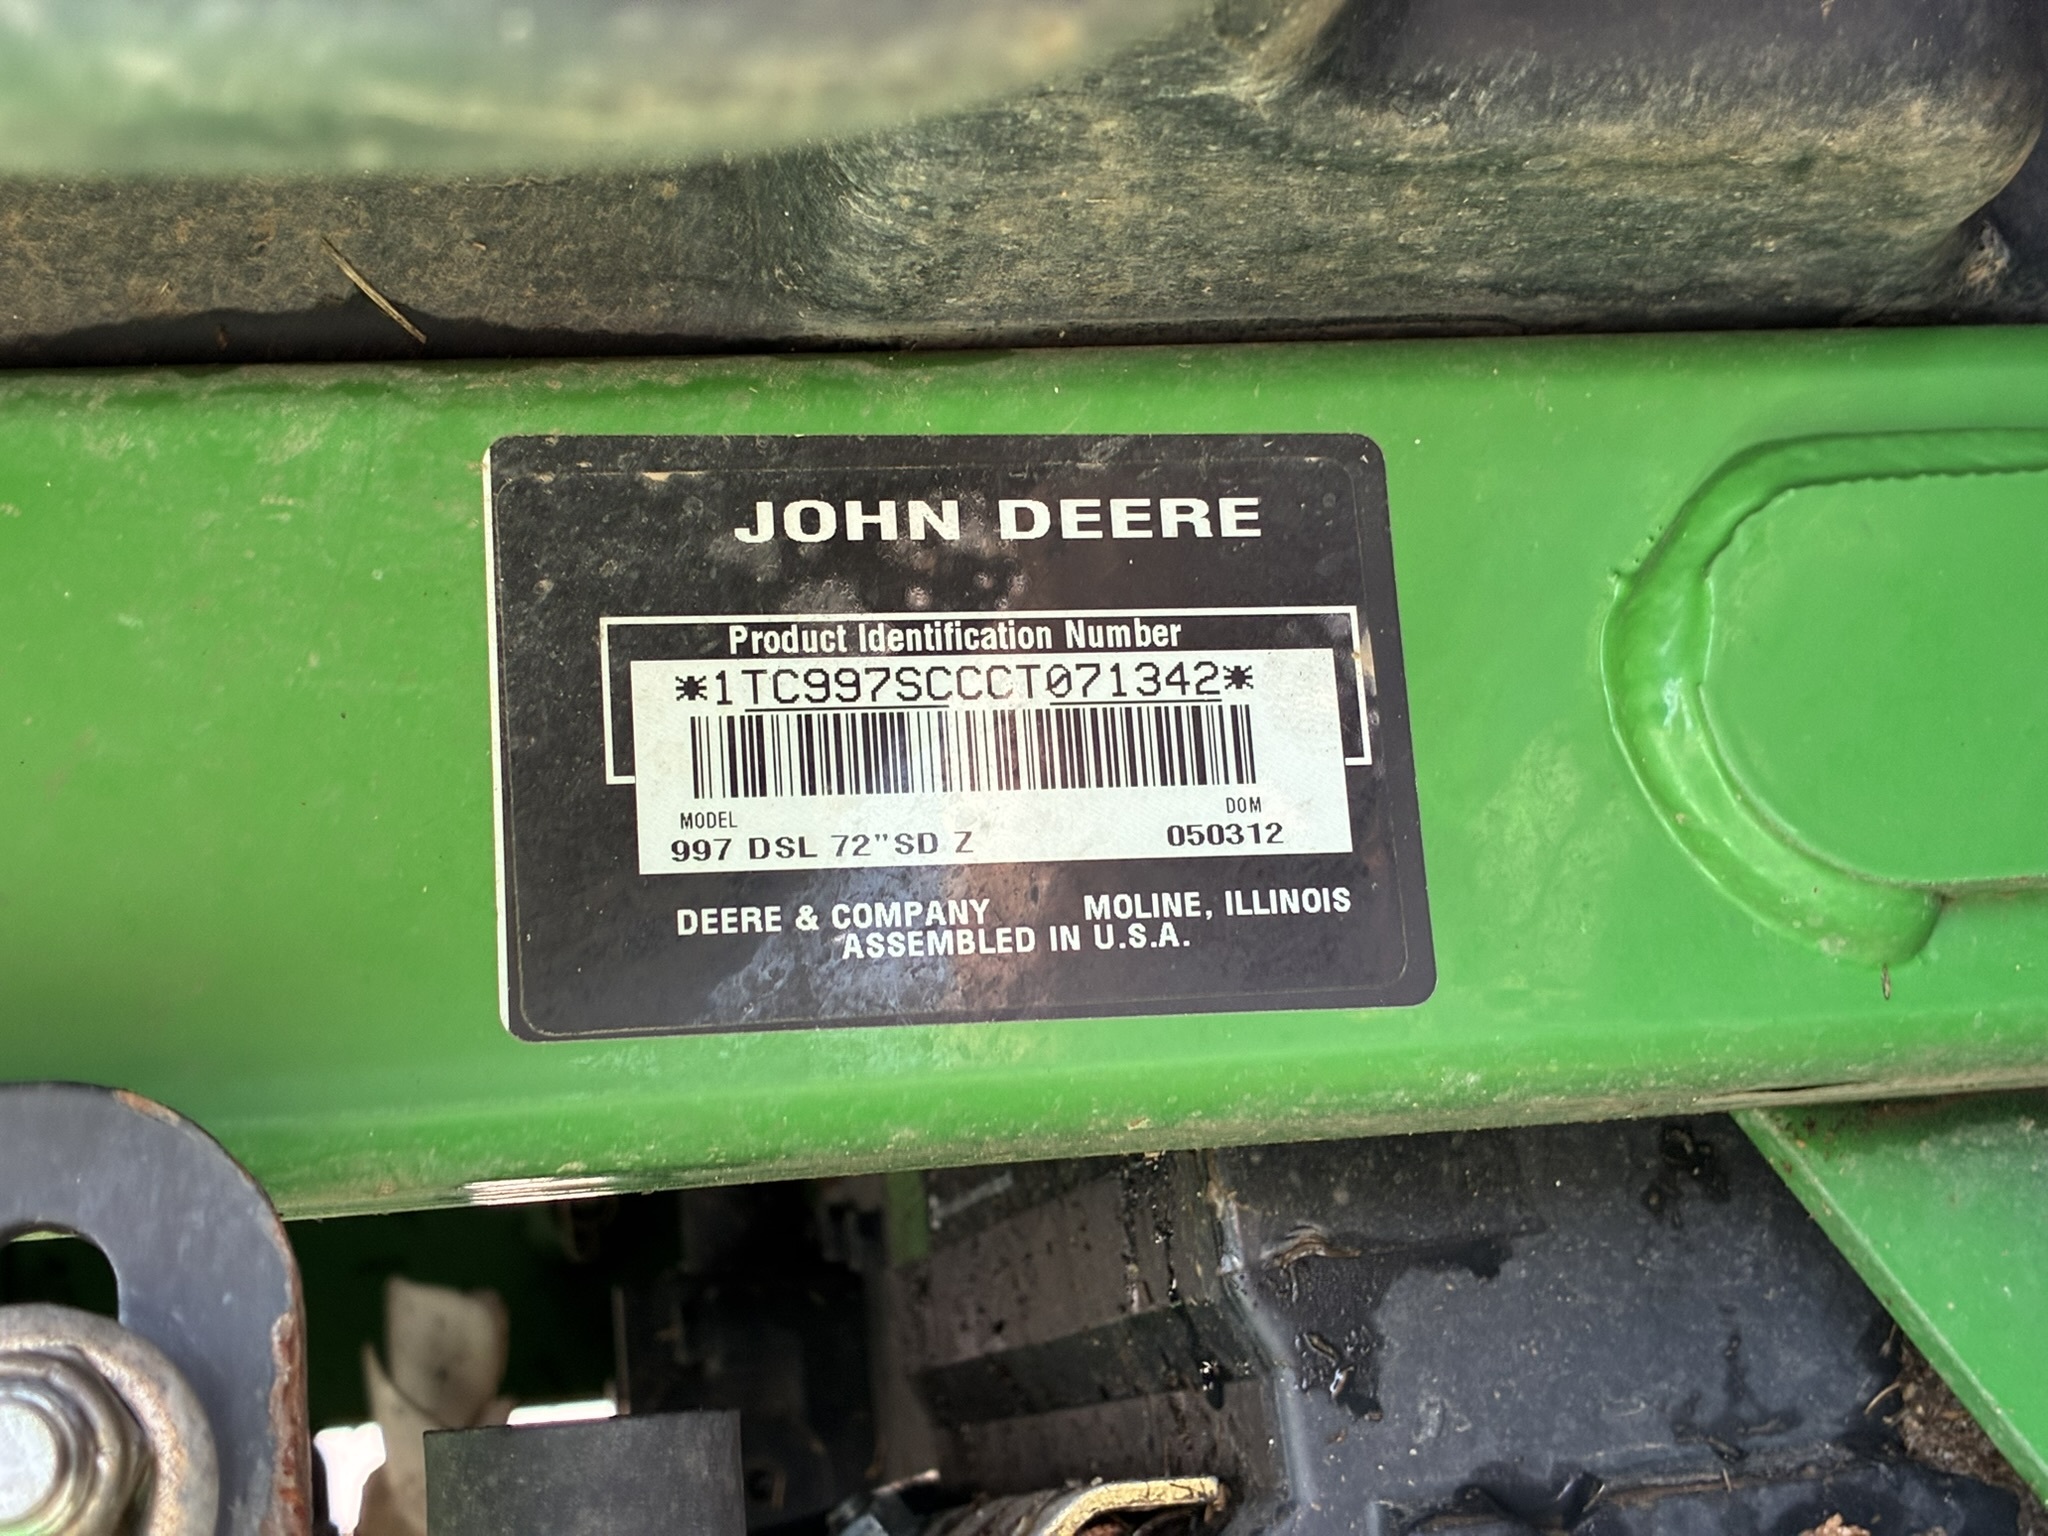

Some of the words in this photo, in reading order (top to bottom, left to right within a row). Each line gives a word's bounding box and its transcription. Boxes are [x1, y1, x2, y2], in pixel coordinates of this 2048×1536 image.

[734, 499, 960, 544] JOHN
[998, 497, 1262, 540] DEERE
[729, 624, 847, 655] Product
[858, 619, 1052, 653] Identification
[1066, 617, 1182, 649] Number
[680, 811, 738, 829] MODEL
[1226, 797, 1262, 813] DOM
[671, 838, 732, 862] 997
[749, 836, 818, 859] DSL
[954, 831, 974, 854] Z
[1167, 822, 1284, 846] 050312
[677, 906, 782, 936] DEERE
[795, 905, 820, 931] &
[831, 898, 990, 929] COMPANY
[1084, 890, 1213, 922] MOLINE,
[1225, 887, 1352, 918] ILLINOIS
[842, 927, 1035, 960] ASSEMBLED
[1050, 925, 1081, 952] IN
[1093, 922, 1191, 951] U.S.A.
